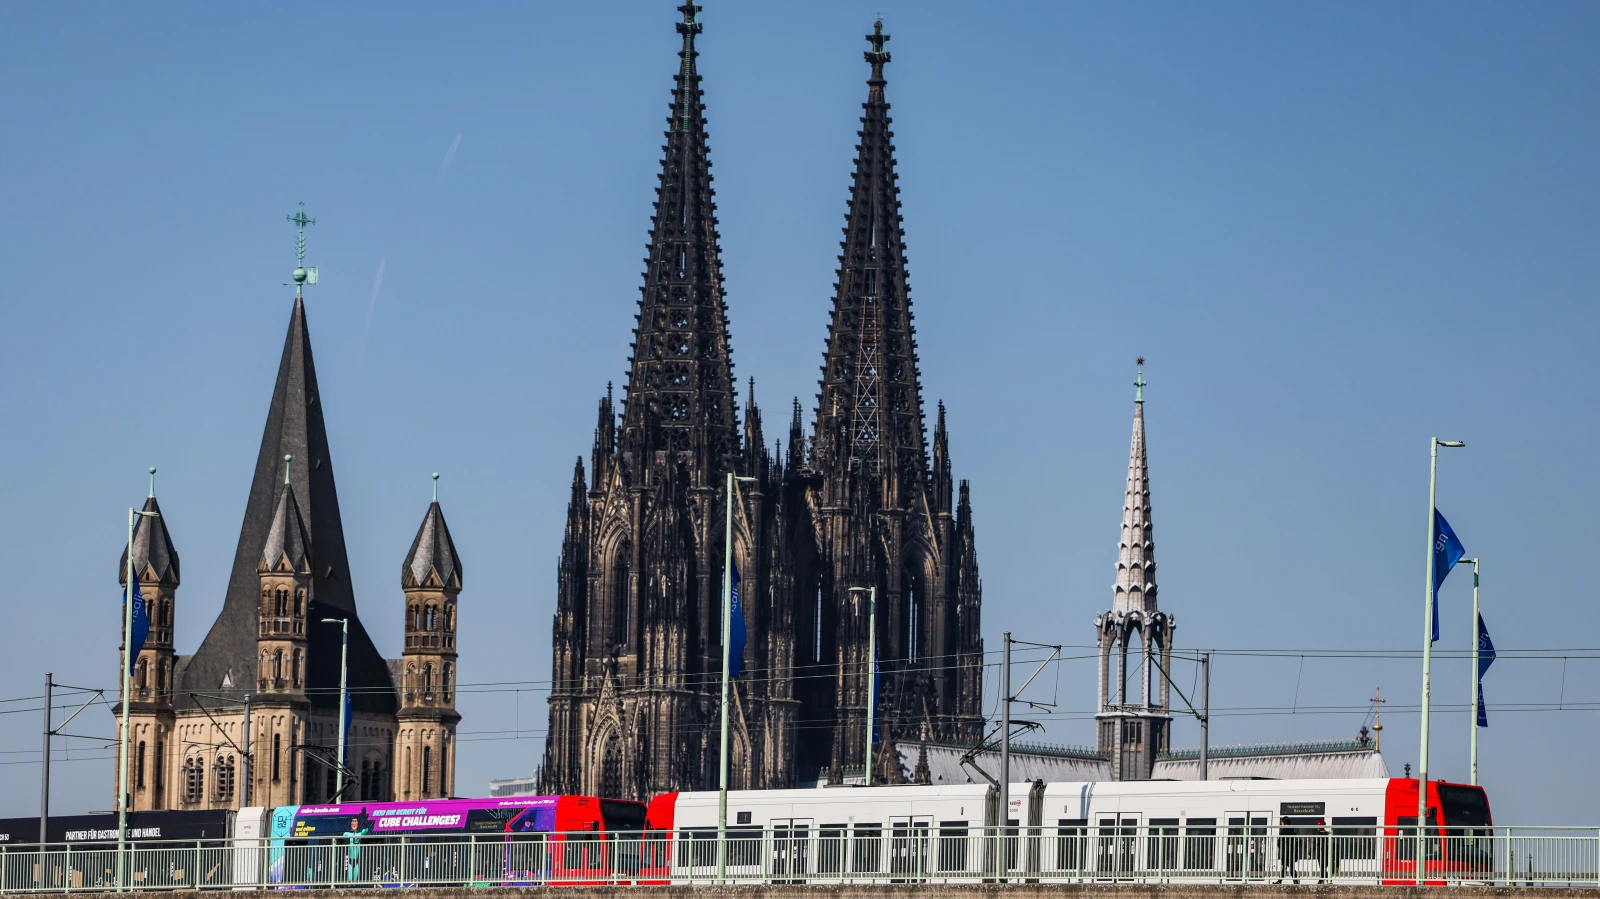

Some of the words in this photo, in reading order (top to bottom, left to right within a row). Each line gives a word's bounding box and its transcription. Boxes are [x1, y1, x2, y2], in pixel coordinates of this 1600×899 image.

[379, 817, 401, 827] CUBE
[402, 815, 460, 826] CHALLENGES?
[65, 830, 87, 840] PARTNER
[88, 828, 97, 840] FÜR
[97, 828, 131, 840] GASTRONIE
[131, 828, 142, 838] UND
[142, 828, 161, 838] HANDEL
